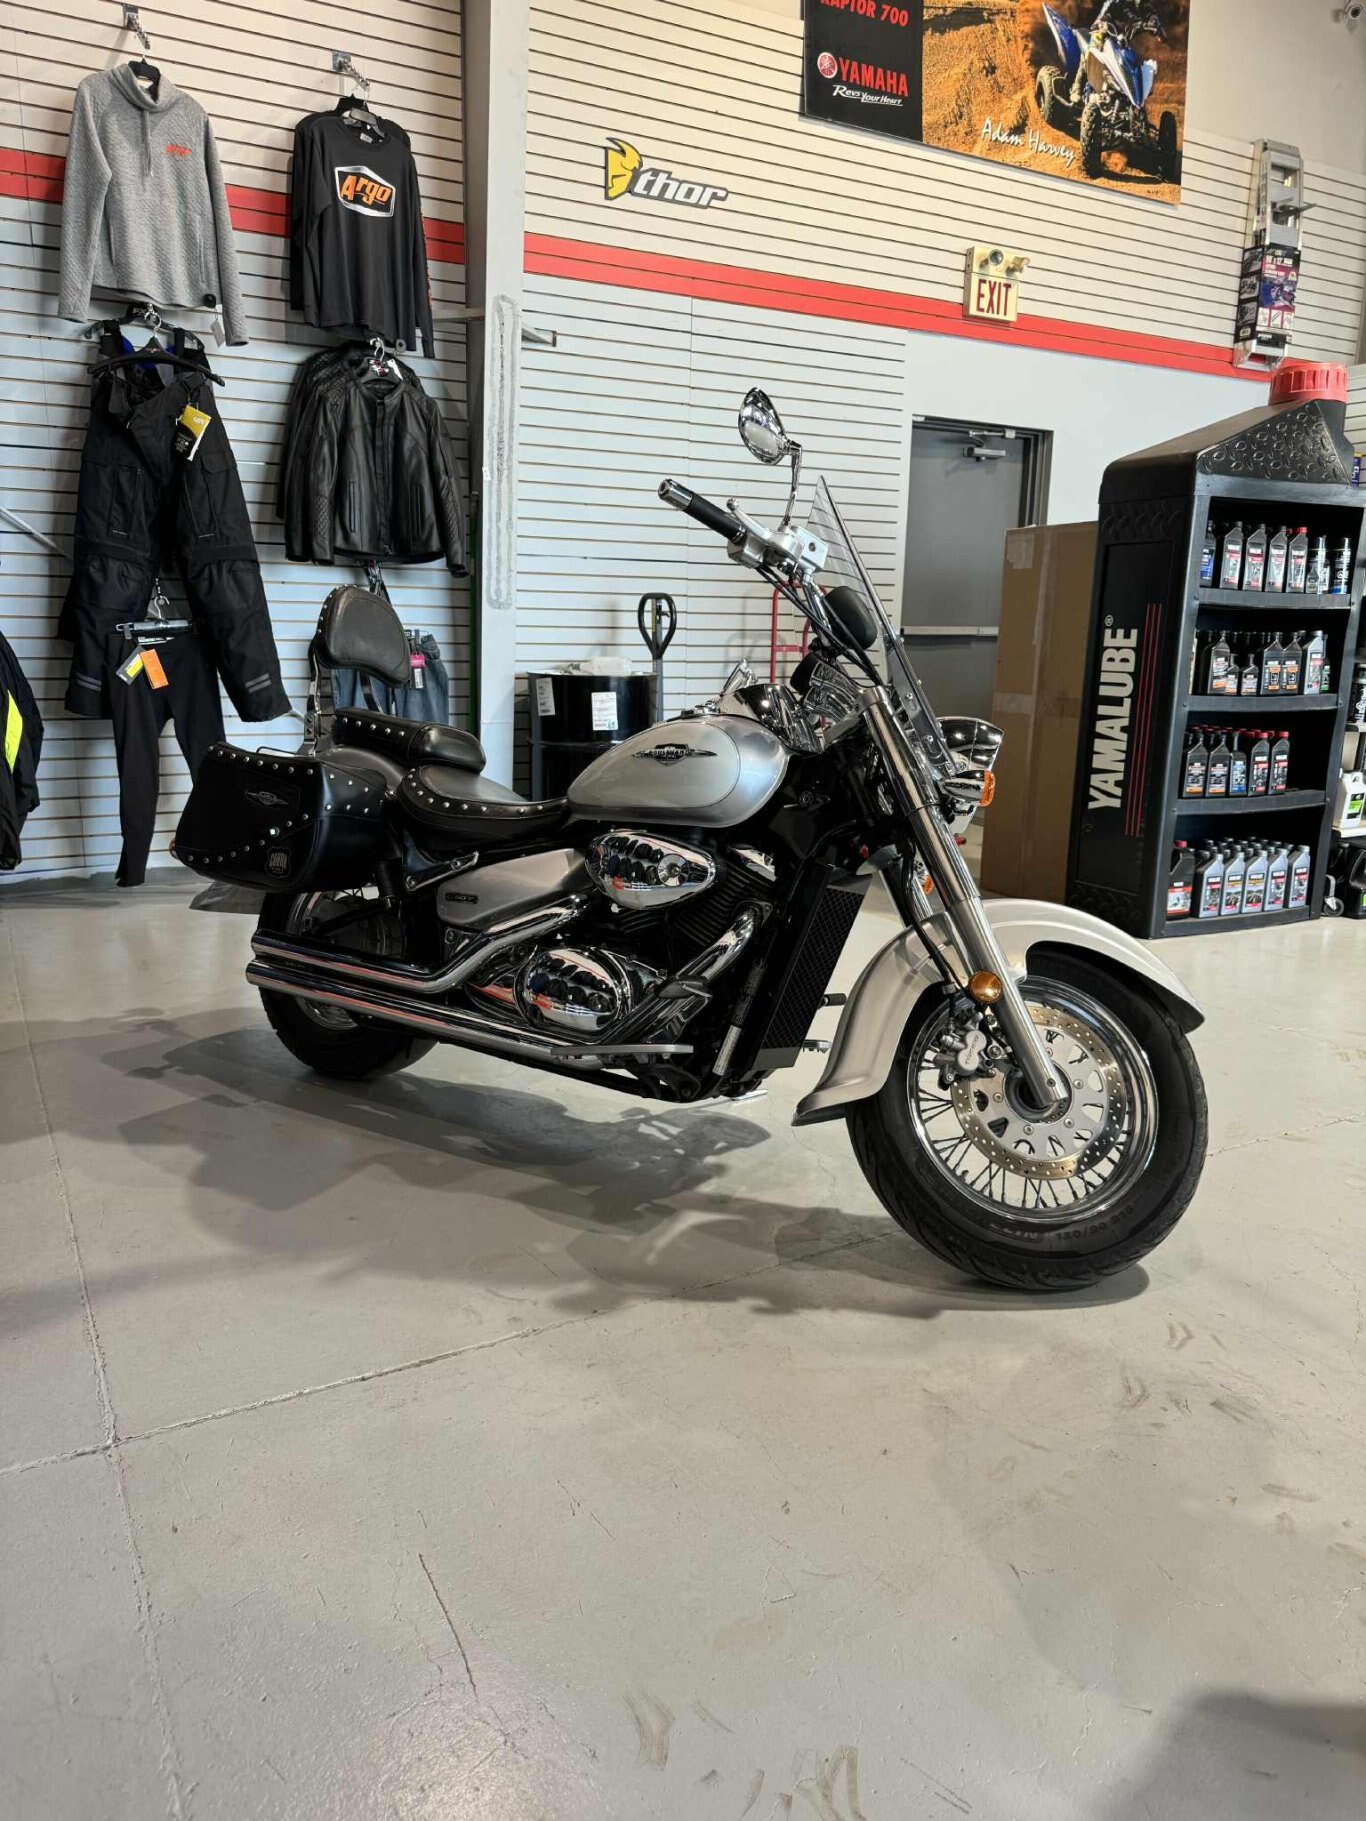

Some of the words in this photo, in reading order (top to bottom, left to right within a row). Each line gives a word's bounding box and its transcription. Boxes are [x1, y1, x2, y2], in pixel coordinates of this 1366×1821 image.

[820, 0, 876, 18] PTOR
[880, 4, 909, 27] 700
[832, 84, 862, 98] Revs
[861, 92, 880, 103] Your
[880, 95, 903, 105] Heart
[839, 57, 908, 97] YAMAHA
[981, 116, 1023, 146] Adam
[1028, 128, 1076, 168] Harvey
[340, 174, 392, 206] Argo
[632, 169, 728, 208] thor
[976, 278, 1012, 317] EXIT
